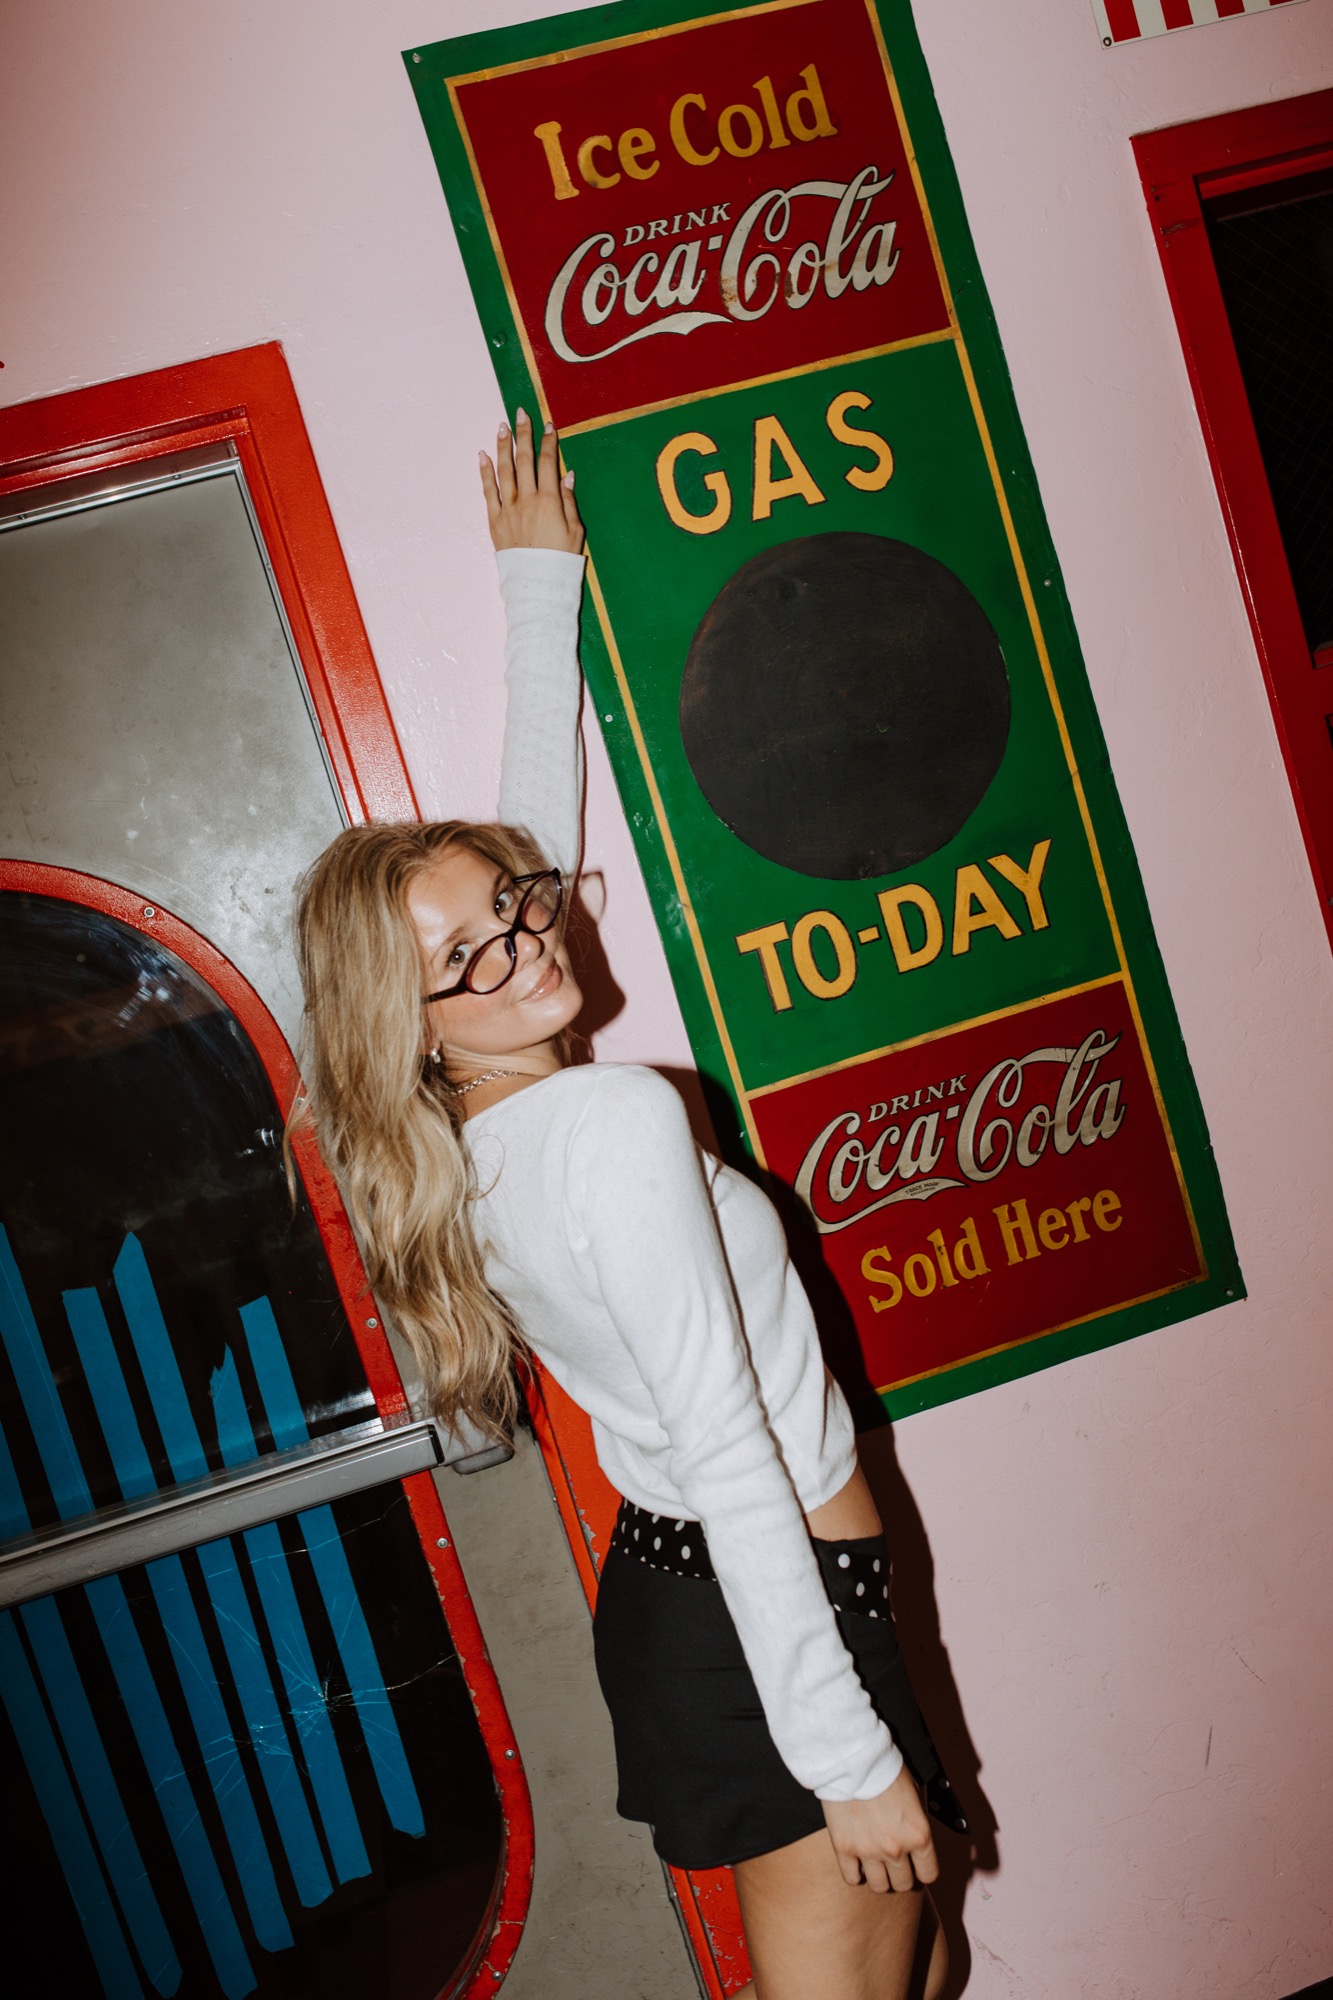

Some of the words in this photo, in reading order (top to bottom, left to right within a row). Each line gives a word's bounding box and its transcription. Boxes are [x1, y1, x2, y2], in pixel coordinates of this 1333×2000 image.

[534, 121, 660, 200] Ice
[670, 63, 838, 166] Cold
[544, 164, 901, 363] Coca-Cola
[623, 203, 731, 247] DRINK
[655, 390, 895, 536] GAS
[734, 837, 1052, 1014] TO-DAY
[793, 1029, 1128, 1234] Coca-Cola
[867, 1074, 968, 1123] DRINK
[860, 1216, 991, 1313] Sold
[992, 1188, 1123, 1266] Here
